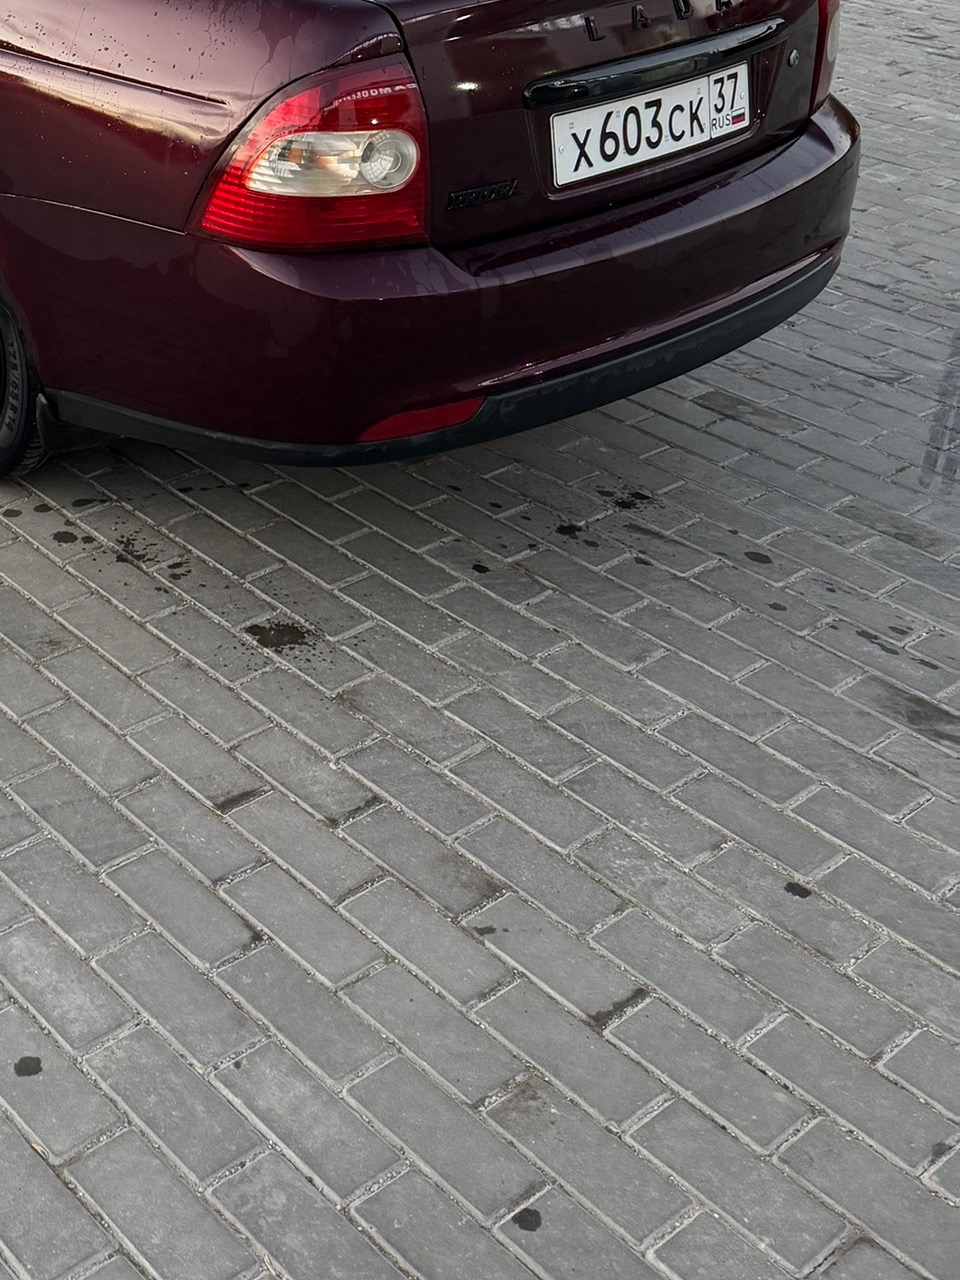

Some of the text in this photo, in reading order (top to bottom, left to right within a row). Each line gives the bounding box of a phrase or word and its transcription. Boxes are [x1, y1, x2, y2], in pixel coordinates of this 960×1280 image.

[570, 72, 739, 173] Х603СК 37
[711, 113, 731, 131] RUS
